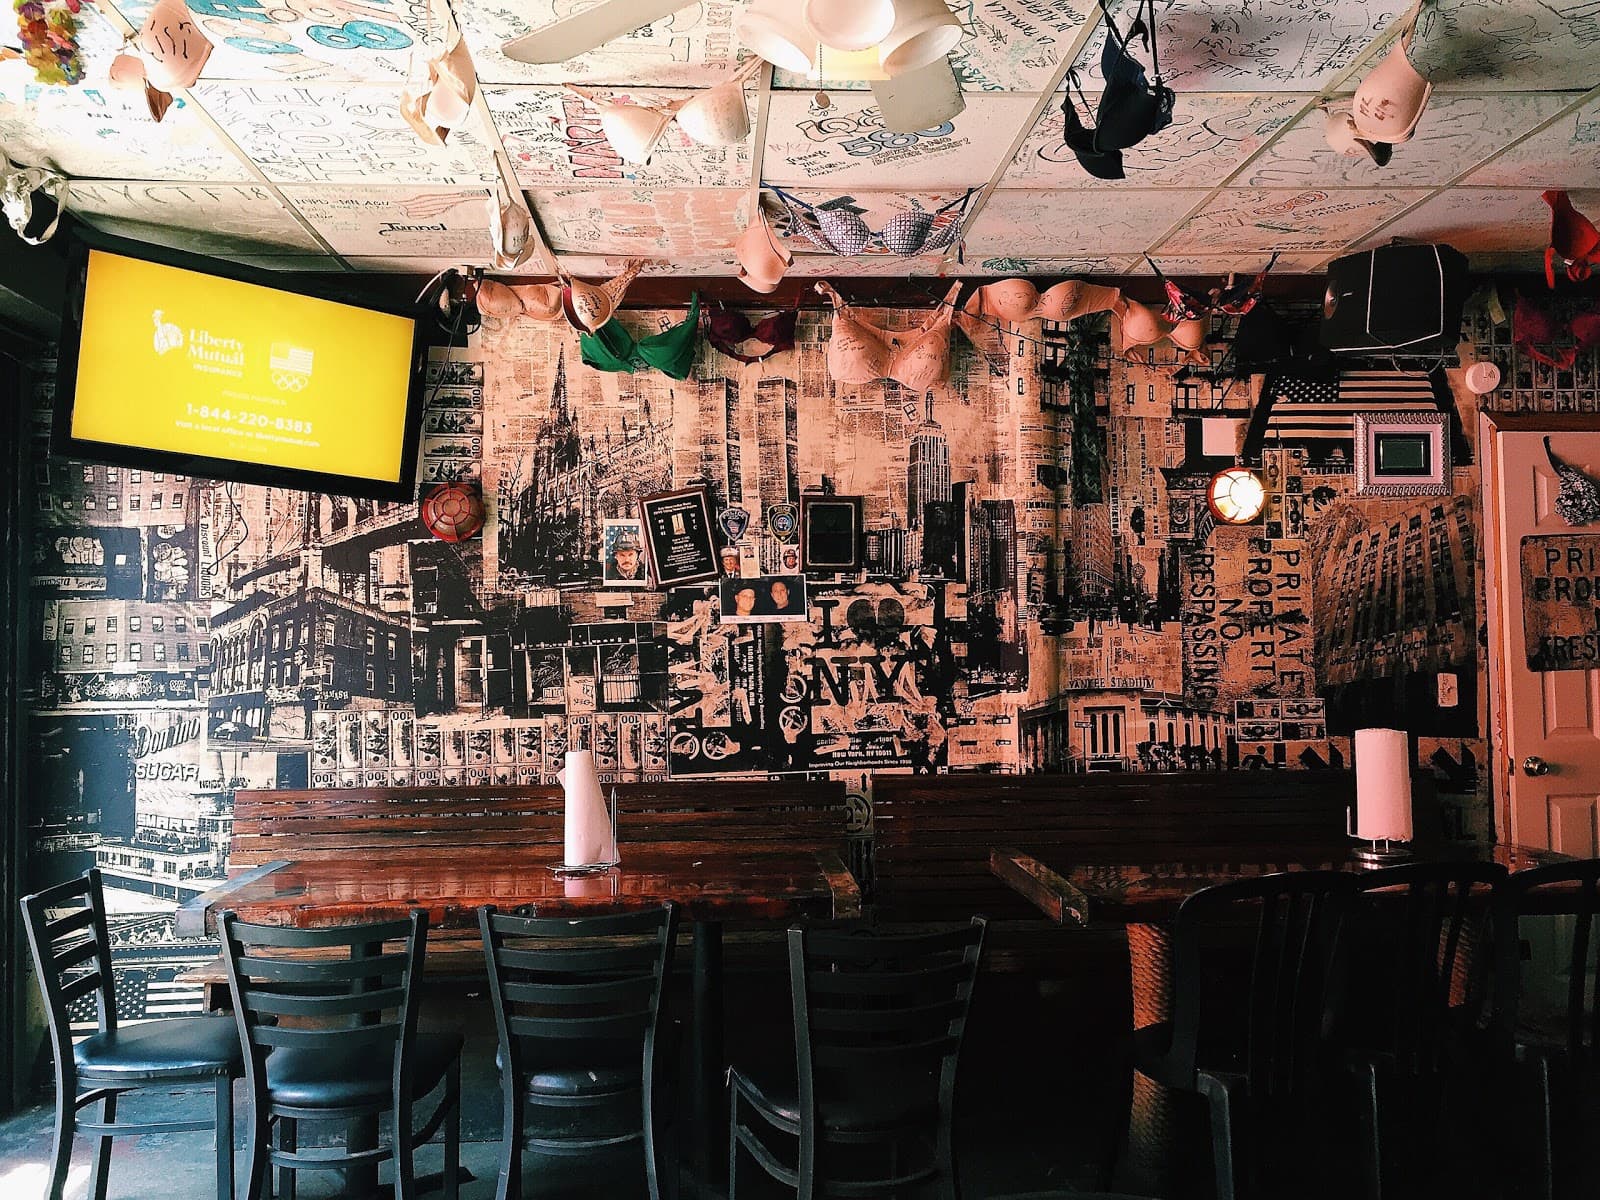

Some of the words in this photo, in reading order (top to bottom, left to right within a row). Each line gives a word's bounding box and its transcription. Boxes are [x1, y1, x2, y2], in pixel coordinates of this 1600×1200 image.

[189, 327, 244, 352] Liberty
[188, 343, 245, 366] Mutual
[186, 402, 314, 435] 1-844-220-8383
[1190, 546, 1219, 698] RESPASSING
[1110, 677, 1156, 690] STADIUM
[392, 711, 412, 721] 100
[135, 717, 200, 759] Domino
[135, 762, 200, 782] SUGAR
